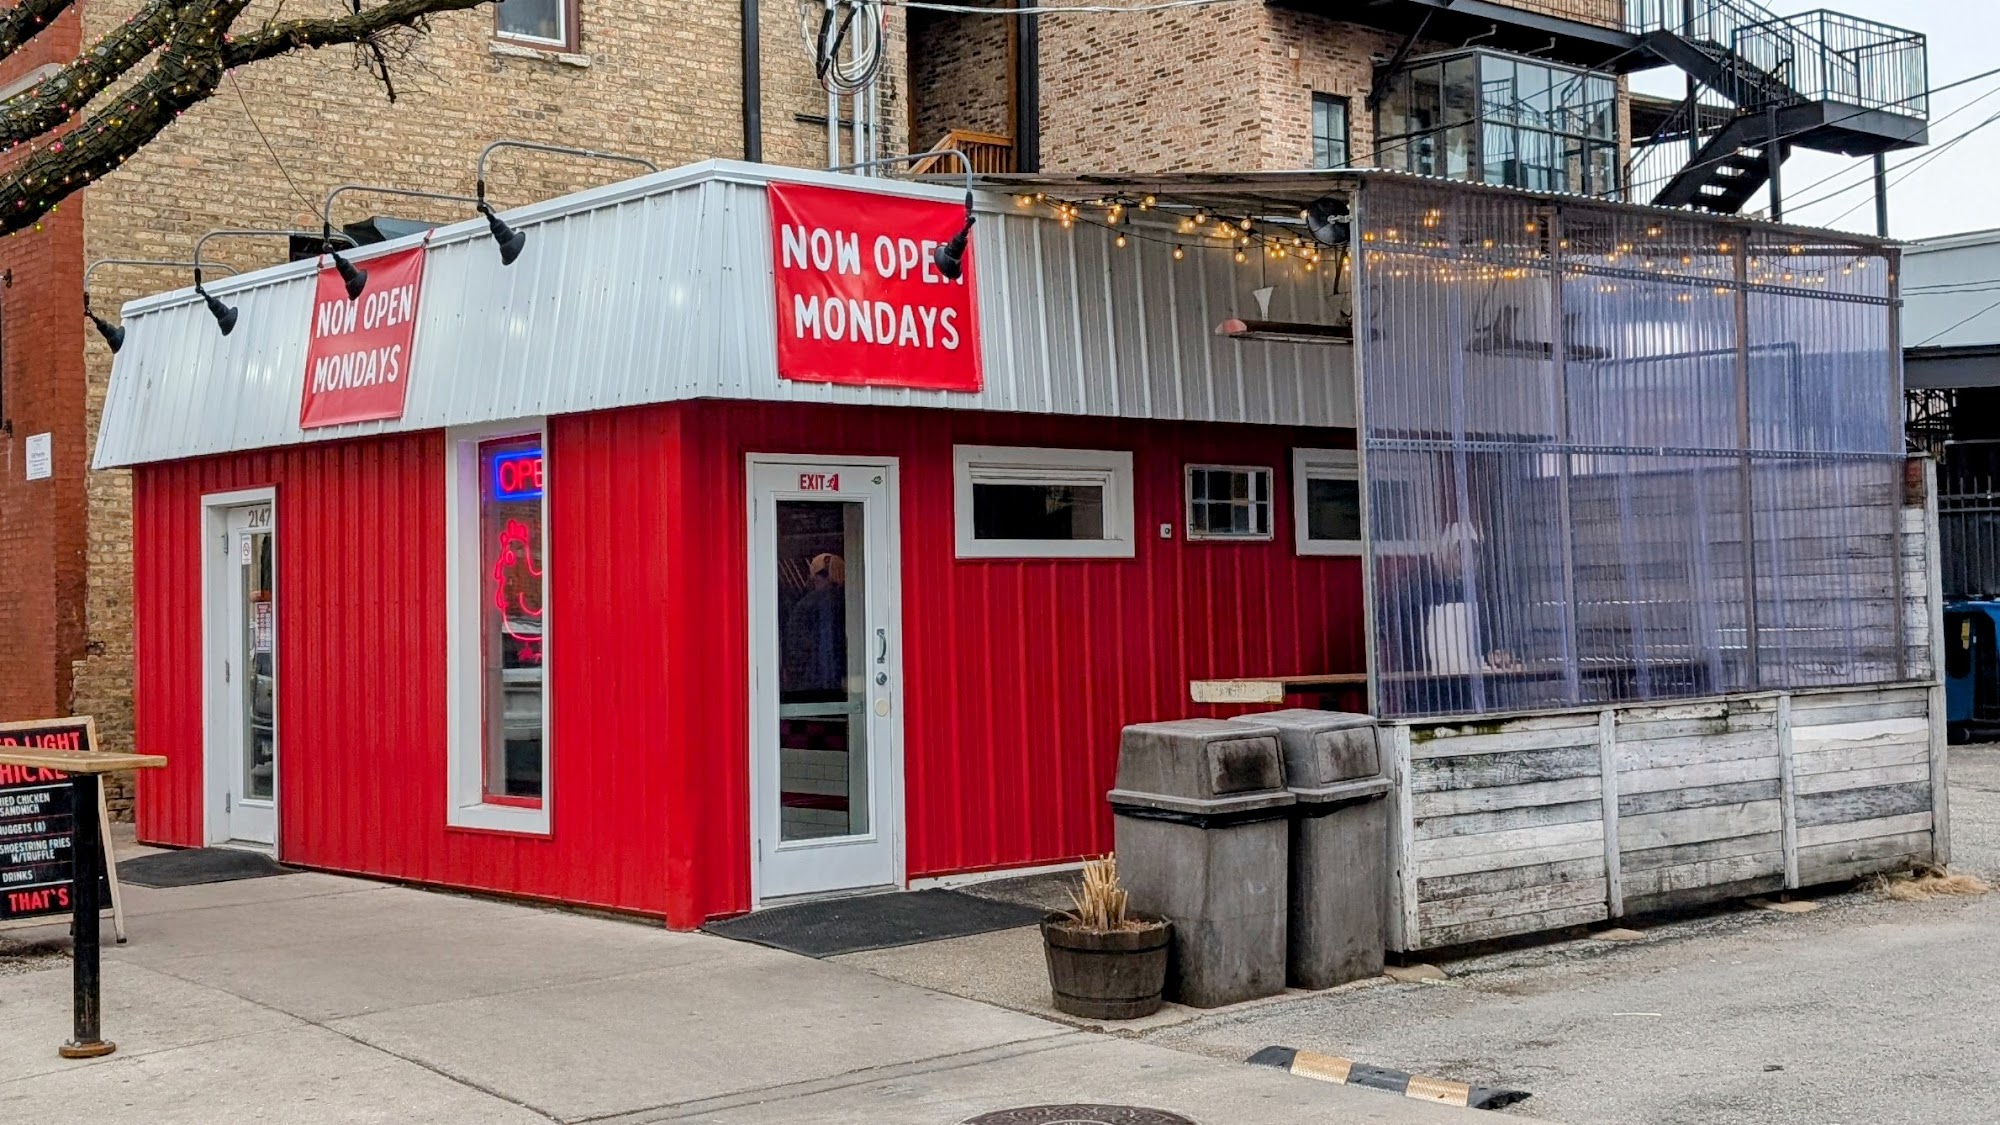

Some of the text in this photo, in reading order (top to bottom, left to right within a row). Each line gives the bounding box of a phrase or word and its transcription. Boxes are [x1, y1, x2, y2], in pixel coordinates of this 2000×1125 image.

[781, 223, 964, 285] NOW OPE
[315, 283, 414, 339] NOW OPEN
[794, 293, 960, 350] MONDAYS
[312, 343, 402, 394] MONDAYS
[800, 473, 826, 490] EXIT
[248, 508, 272, 528] 2147
[16, 793, 50, 804] CHICKEN
[0, 804, 39, 816] SANDWICH
[34, 821, 46, 832] (8)
[0, 838, 70, 855] SHOESTRING FRIES
[11, 850, 55, 863] W/TRUFFLE
[2, 871, 33, 882] DRINKS
